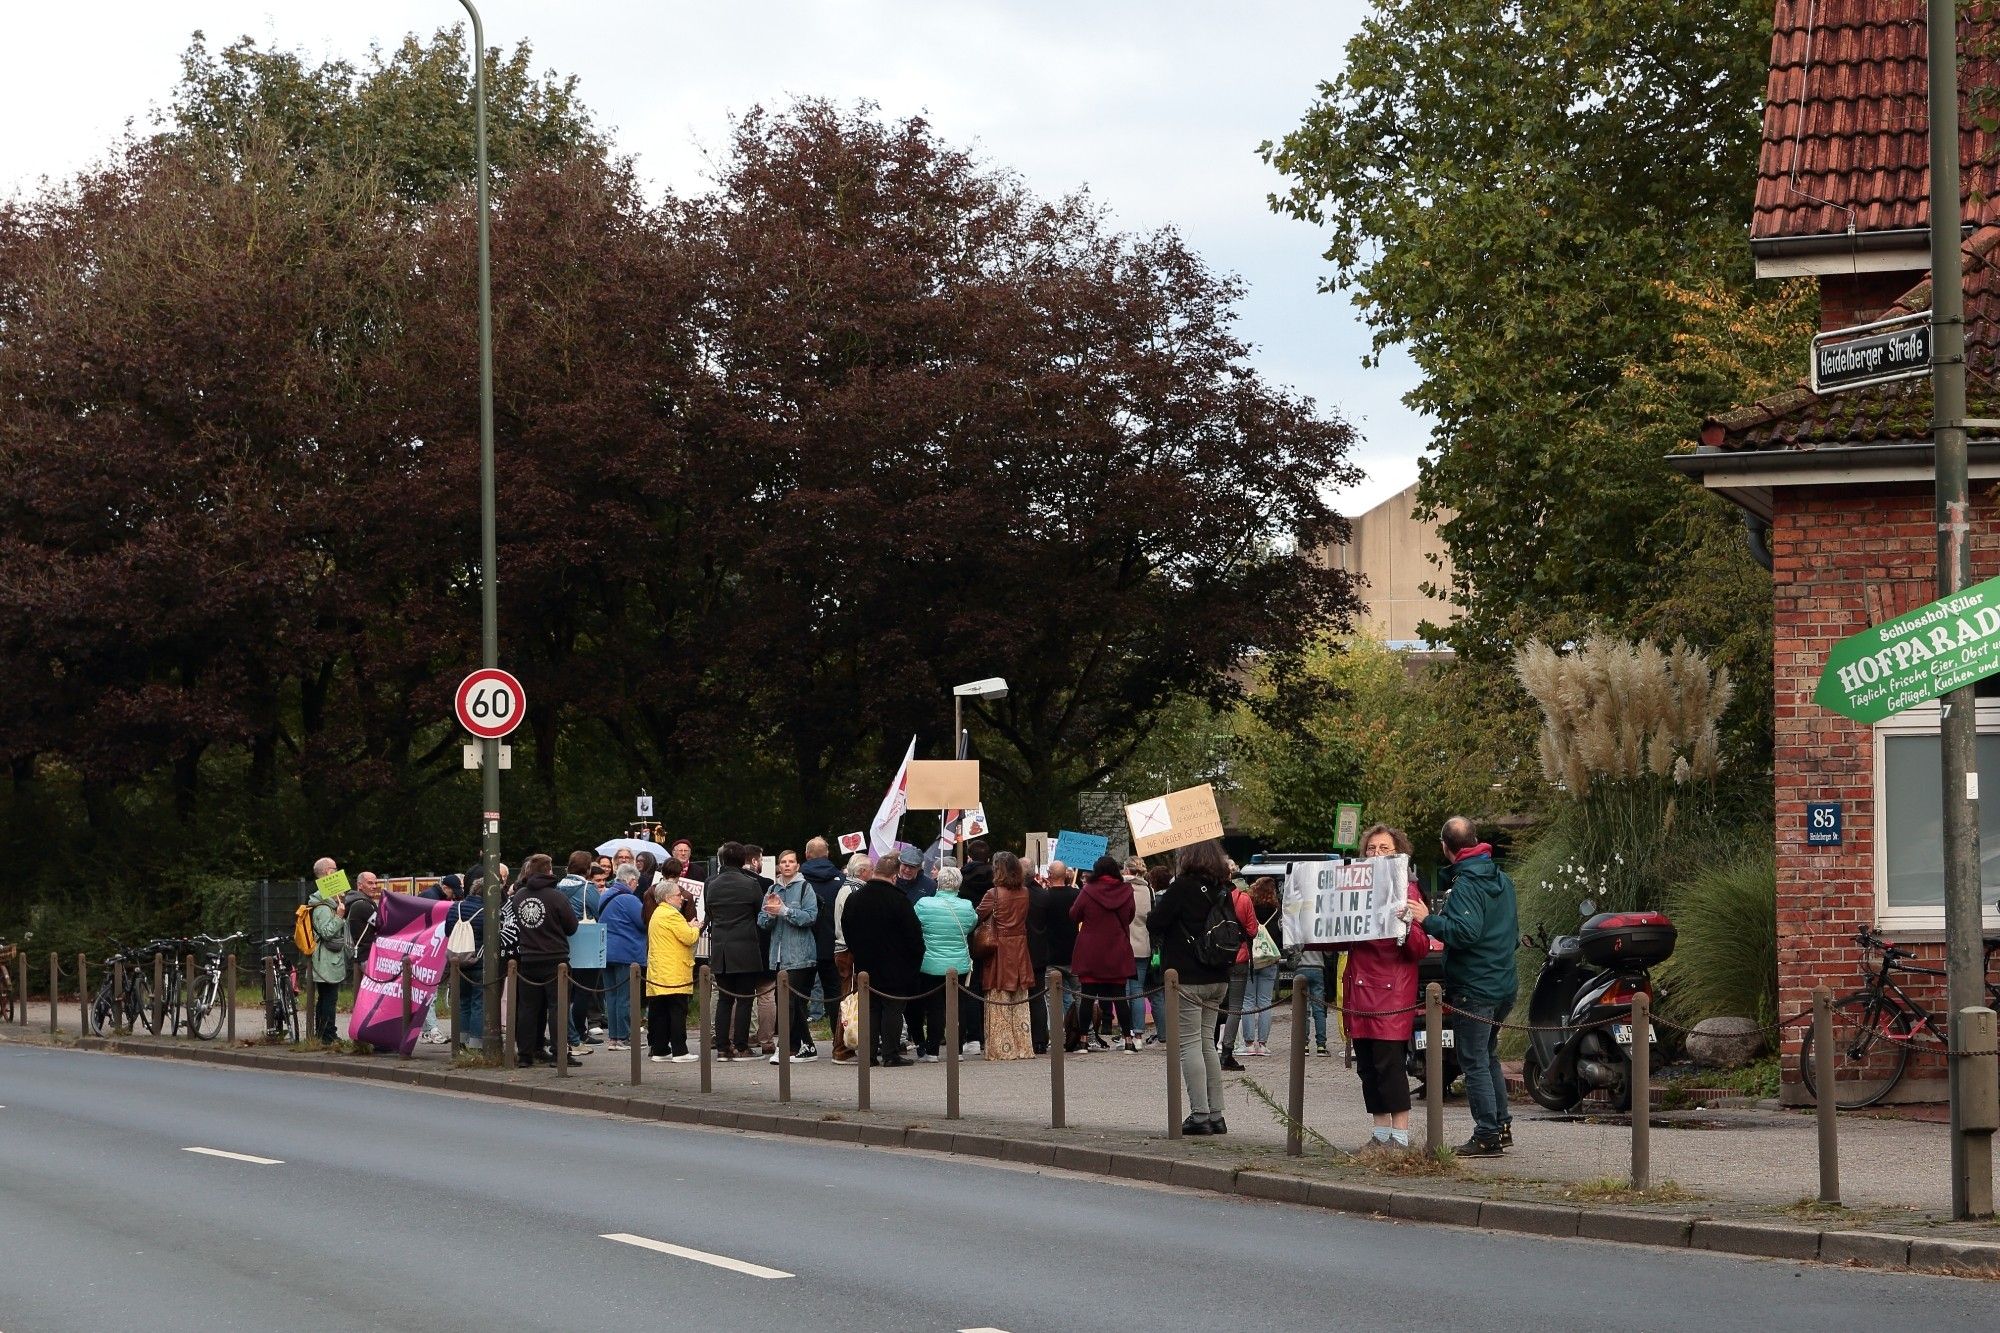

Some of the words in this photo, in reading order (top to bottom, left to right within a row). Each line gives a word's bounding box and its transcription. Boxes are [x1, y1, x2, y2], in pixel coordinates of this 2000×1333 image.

[1821, 346, 1883, 376] Heidelberger
[1888, 333, 1923, 362] Straße
[1950, 593, 1983, 614] Eller
[1849, 686, 1887, 709] Täglich
[1890, 668, 1927, 692] frische
[1930, 658, 1958, 675] Eier,
[1961, 641, 1988, 663] Obst
[1992, 640, 2000, 650] u
[1888, 684, 1931, 711] Geflügel,
[1934, 670, 1975, 693] Kuchen
[1978, 655, 1998, 673] und
[472, 688, 510, 718] 60
[1813, 808, 1835, 828] 85
[1159, 832, 1183, 846] WIEDER
[1184, 828, 1192, 839] IST
[1318, 870, 1334, 890] GIB
[1336, 867, 1373, 888] NAZIS
[1315, 891, 1373, 914] KEINE
[1314, 915, 1372, 938] CHANCE
